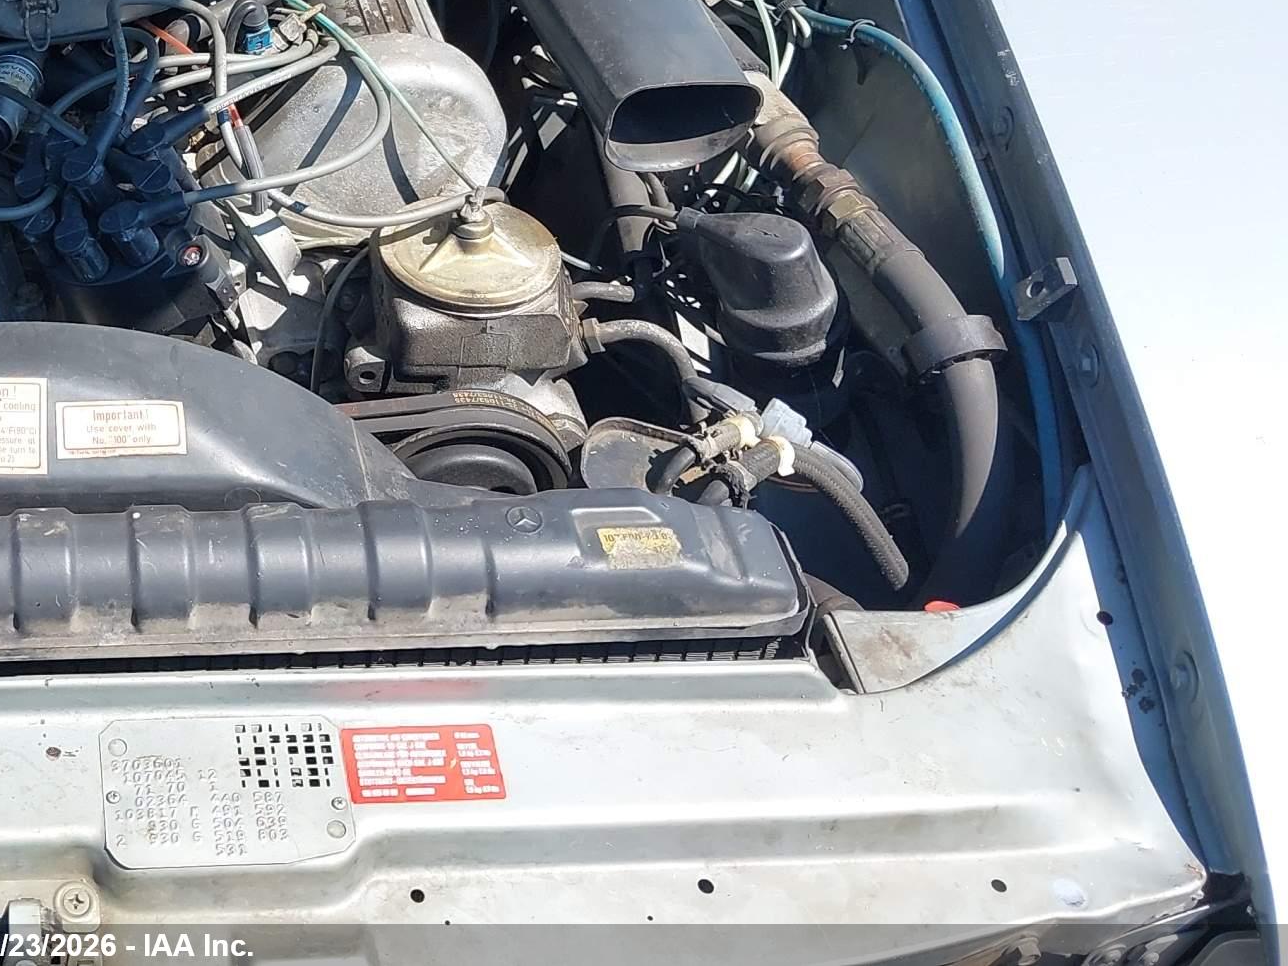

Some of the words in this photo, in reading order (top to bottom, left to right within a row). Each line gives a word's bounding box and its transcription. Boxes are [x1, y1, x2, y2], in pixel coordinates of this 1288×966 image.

[3, 401, 36, 411] cooling
[108, 424, 132, 432] cover
[132, 434, 152, 444] only
